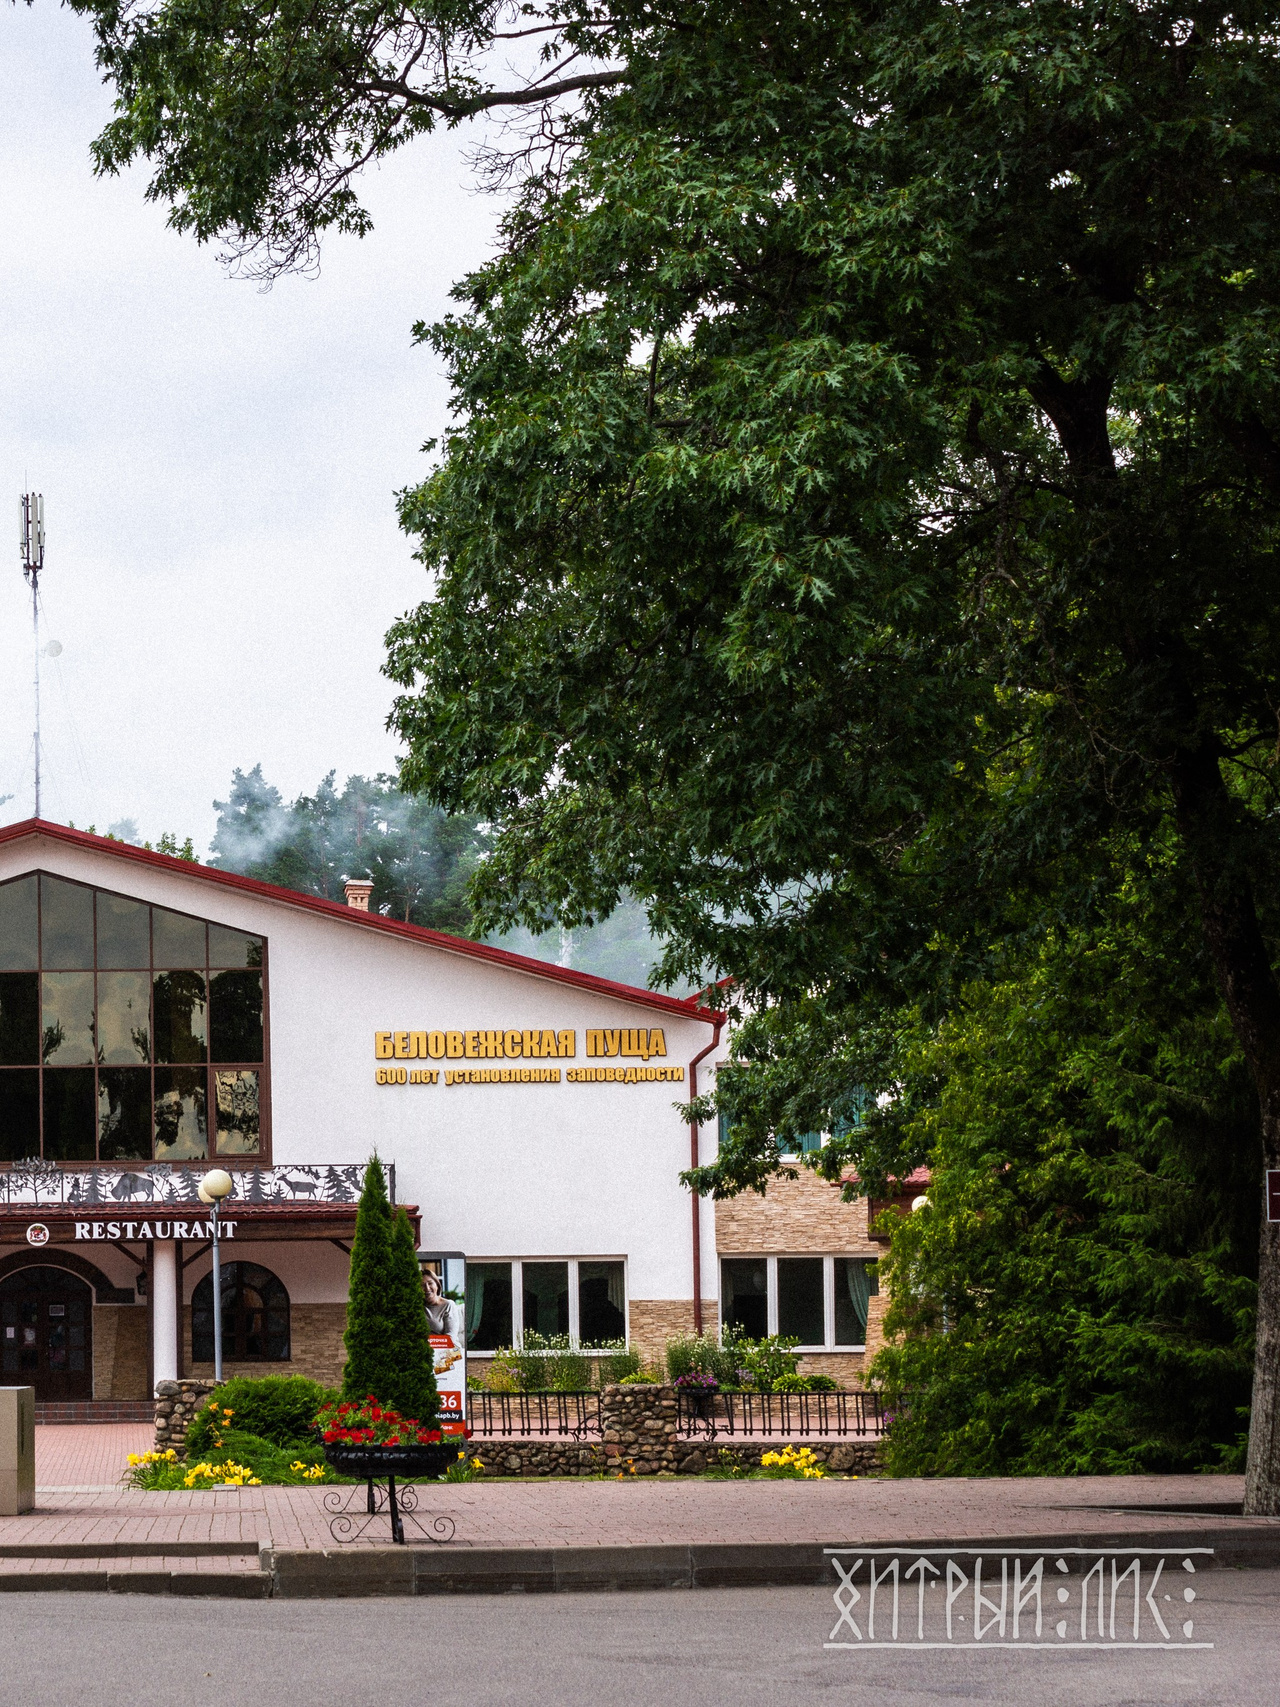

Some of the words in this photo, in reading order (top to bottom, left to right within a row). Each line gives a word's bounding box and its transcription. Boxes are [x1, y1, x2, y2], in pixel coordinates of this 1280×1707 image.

[374, 1029, 576, 1060] БЕЛОВЕЖСКАЯ
[585, 1028, 667, 1061] ПУЩА
[375, 1066, 407, 1086] 600
[409, 1069, 439, 1086] лет
[444, 1067, 561, 1087] установления
[566, 1065, 685, 1085] заповедности
[74, 1221, 238, 1240] RESTAURANT
